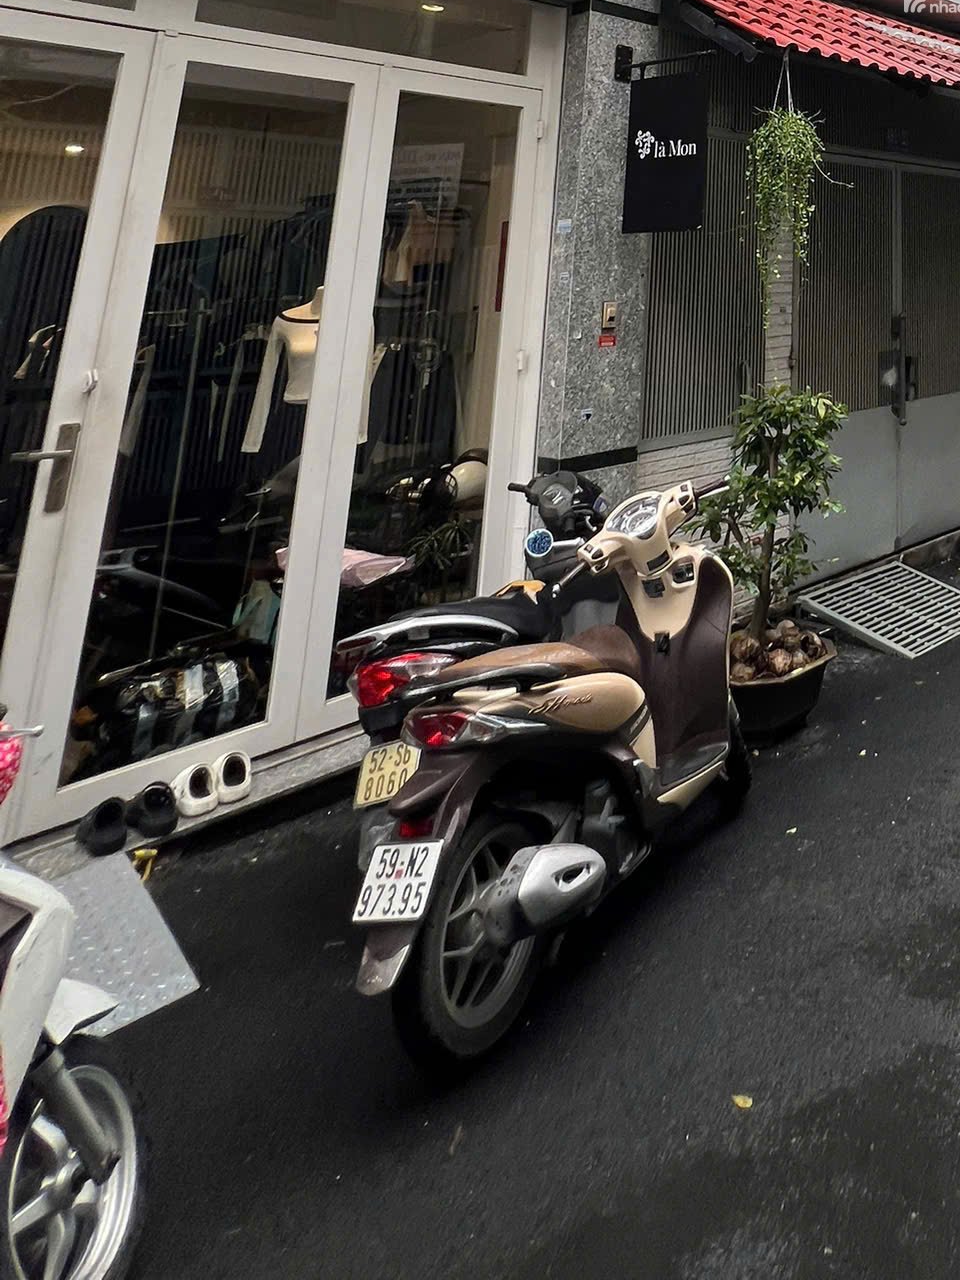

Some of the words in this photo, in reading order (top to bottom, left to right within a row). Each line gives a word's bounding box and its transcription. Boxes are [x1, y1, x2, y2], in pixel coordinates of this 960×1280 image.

[653, 141, 666, 158] là
[669, 139, 697, 157] Mon
[357, 881, 426, 917] 973.95
